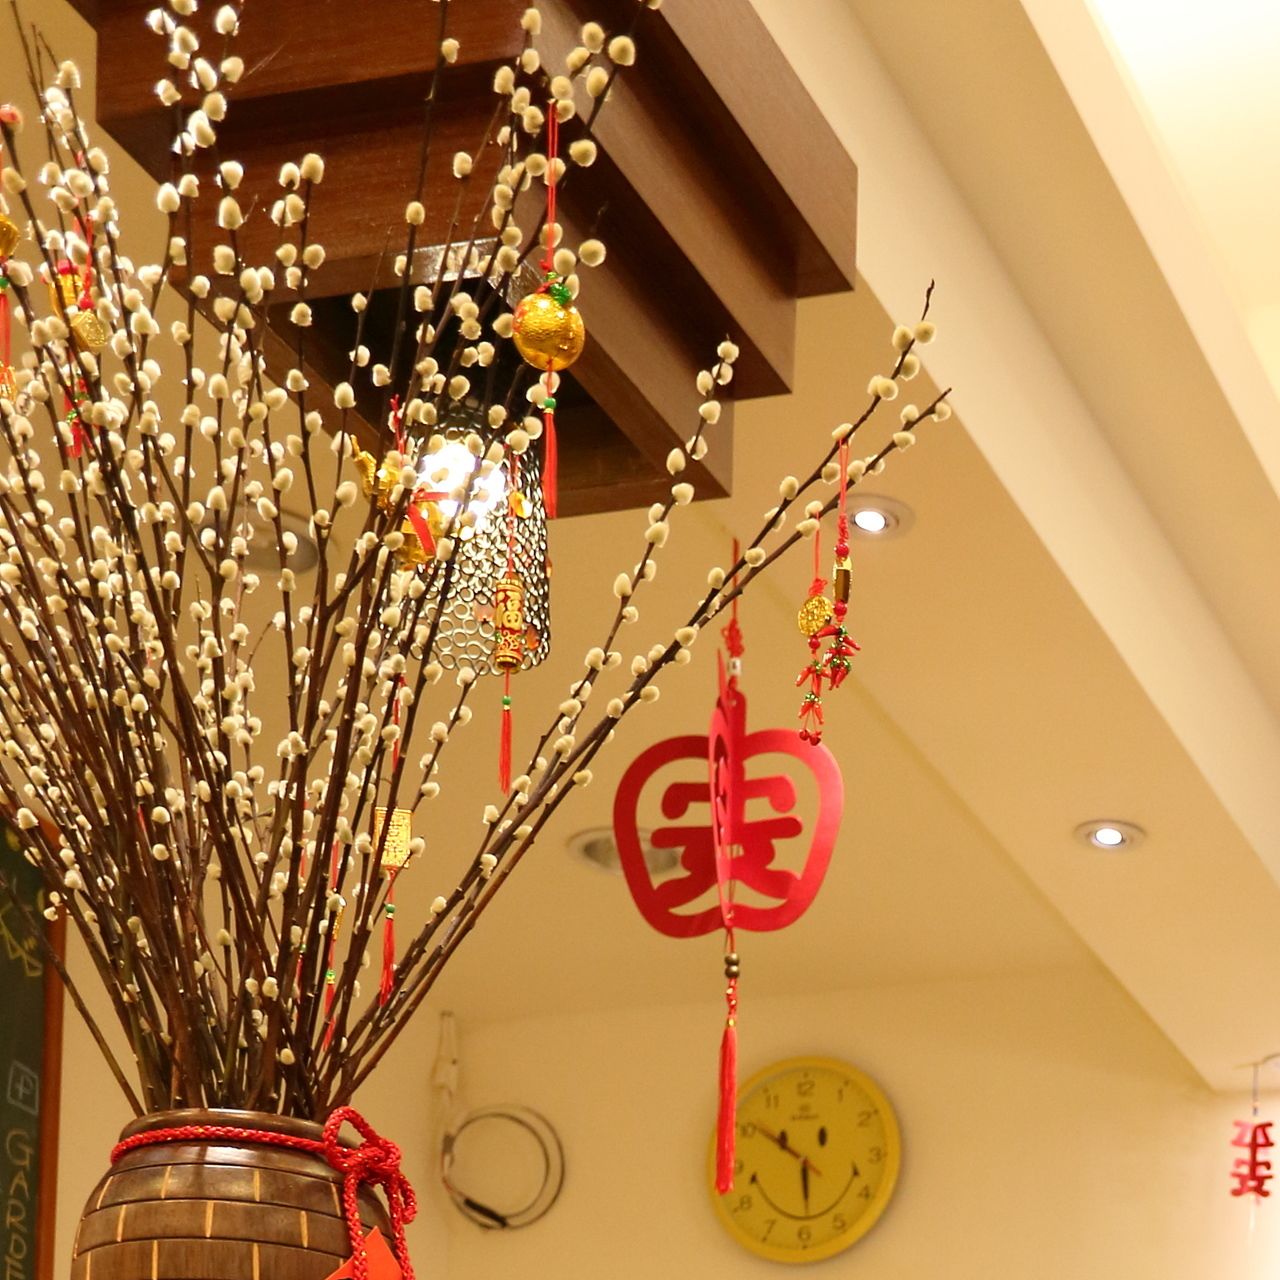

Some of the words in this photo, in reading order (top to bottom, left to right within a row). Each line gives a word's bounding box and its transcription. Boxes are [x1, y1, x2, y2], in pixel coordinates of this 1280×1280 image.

[857, 1111, 872, 1127] 2
[868, 1147, 882, 1164] 3
[857, 1184, 871, 1200] 4
[738, 1194, 752, 1211] 8
[832, 1214, 846, 1233] 5
[798, 1225, 811, 1242] 6
